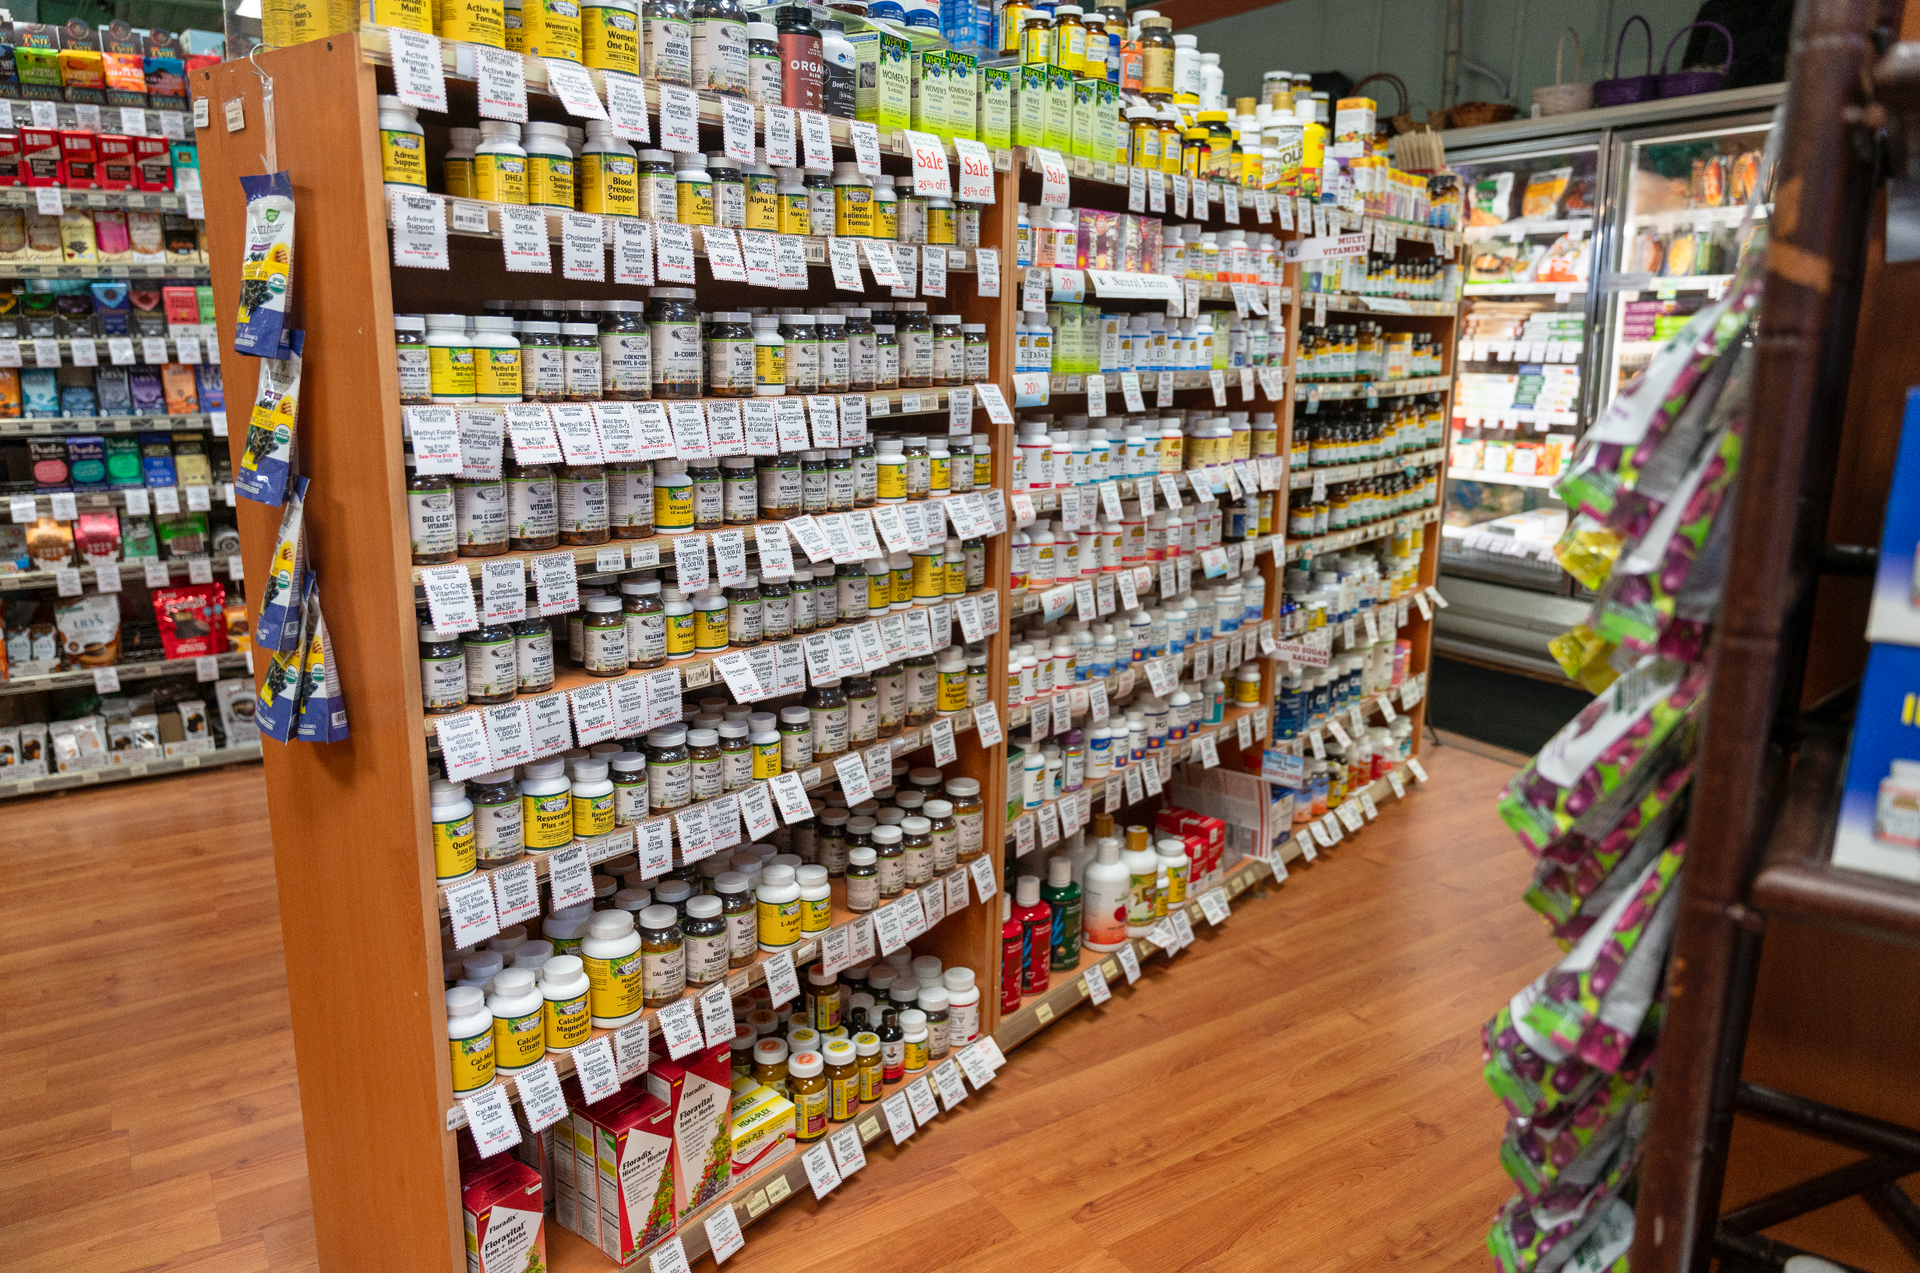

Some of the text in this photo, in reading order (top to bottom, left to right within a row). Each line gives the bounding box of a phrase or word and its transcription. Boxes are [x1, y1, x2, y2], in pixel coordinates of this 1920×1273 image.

[607, 41, 621, 50] One
[884, 35, 907, 49] WHOLE
[718, 44, 740, 52] SOFTGEL
[405, 51, 429, 61] Active
[925, 54, 948, 67] WHOLE
[950, 53, 973, 66] WHOLE
[401, 58, 436, 70] Woman's
[410, 67, 428, 76] Multi
[482, 66, 520, 79] Active Man
[988, 70, 1008, 81] WHOLE
[1025, 67, 1046, 80] WHOLE
[1050, 67, 1071, 80] WHOLE
[489, 74, 515, 84] Formula
[882, 69, 909, 85] WOMEN'S
[925, 85, 947, 96] WOMEN'S
[988, 97, 1008, 107] WOMEN'S
[1026, 96, 1039, 105] MEN'S
[1052, 98, 1067, 108] MEN'S
[1098, 110, 1110, 119] MEN'S
[394, 150, 419, 160] Adrenal
[917, 149, 943, 170] Sale
[394, 158, 420, 167] Support
[964, 157, 989, 177] Sale
[505, 174, 523, 183] DHEA
[1046, 166, 1065, 185] Sale
[613, 177, 632, 186] Blood
[918, 179, 946, 191] 25% off
[608, 186, 635, 195] Pressure
[963, 186, 990, 197] 25% off
[608, 193, 635, 203] Support
[1045, 193, 1067, 204] 25% off
[763, 205, 775, 213] Acid
[852, 205, 867, 213] Super
[407, 215, 434, 224] Adrenal
[848, 219, 871, 227] Formula
[407, 222, 436, 231] Support
[565, 234, 601, 243] Cholesterol
[661, 238, 682, 247] Vitamin
[1338, 236, 1366, 246] MULTI
[571, 241, 596, 250] Support
[1323, 245, 1366, 257] VITAMINS
[1112, 276, 1169, 289] Natural Factors
[1107, 340, 1116, 350] D3
[412, 408, 451, 417] Everything
[512, 421, 531, 429] Methyl
[414, 429, 433, 437] Methyl
[462, 433, 500, 441] Methylfolate
[1018, 501, 1029, 511] 20%
[485, 562, 520, 571] Everything
[450, 582, 468, 591] Caps
[490, 588, 519, 596] Complete
[1302, 646, 1327, 656] SUGAR
[1292, 655, 1328, 665] BALANCE
[653, 685, 675, 693] Selenium
[618, 695, 641, 704] Selenium
[578, 700, 598, 711] Perfect
[537, 709, 561, 720] Vitamin
[494, 723, 515, 733] Vitamin
[446, 731, 472, 741] Sunflower
[554, 862, 586, 877] Resveratrol
[503, 880, 529, 891] Quercetin
[505, 885, 528, 895] Complex
[455, 889, 484, 903] Quercetin
[471, 896, 484, 906] Plus
[706, 1008, 730, 1021] Magnesium
[558, 1018, 582, 1026] Calcium
[563, 1028, 588, 1040] Citrates
[517, 1033, 542, 1046] Calcium
[520, 1041, 541, 1053] Citrate
[478, 1060, 491, 1071] Caps
[583, 1058, 609, 1072] Magnesium
[530, 1080, 550, 1092] Calcium
[683, 1082, 705, 1100] Floradix
[475, 1102, 502, 1117] Cal-Mag
[680, 1094, 713, 1120] Floravital
[807, 1101, 824, 1110] Blood
[481, 1109, 499, 1120] Caps
[680, 1116, 691, 1129] Iron
[699, 1102, 715, 1117] Herbs
[738, 1108, 770, 1129] HEMA-PLEX
[737, 1128, 764, 1149] HEMA-PLEX
[832, 1127, 854, 1142] MEGA FOOD
[839, 1136, 852, 1145] Blood
[622, 1150, 652, 1170] Floradix
[622, 1164, 639, 1178] Hierro
[647, 1146, 668, 1164] Hierbas
[811, 1156, 823, 1167] Blood
[489, 1215, 516, 1234] Floradix
[485, 1223, 524, 1252] Floravital
[486, 1248, 499, 1259] Iron
[508, 1231, 526, 1245] Herbs
